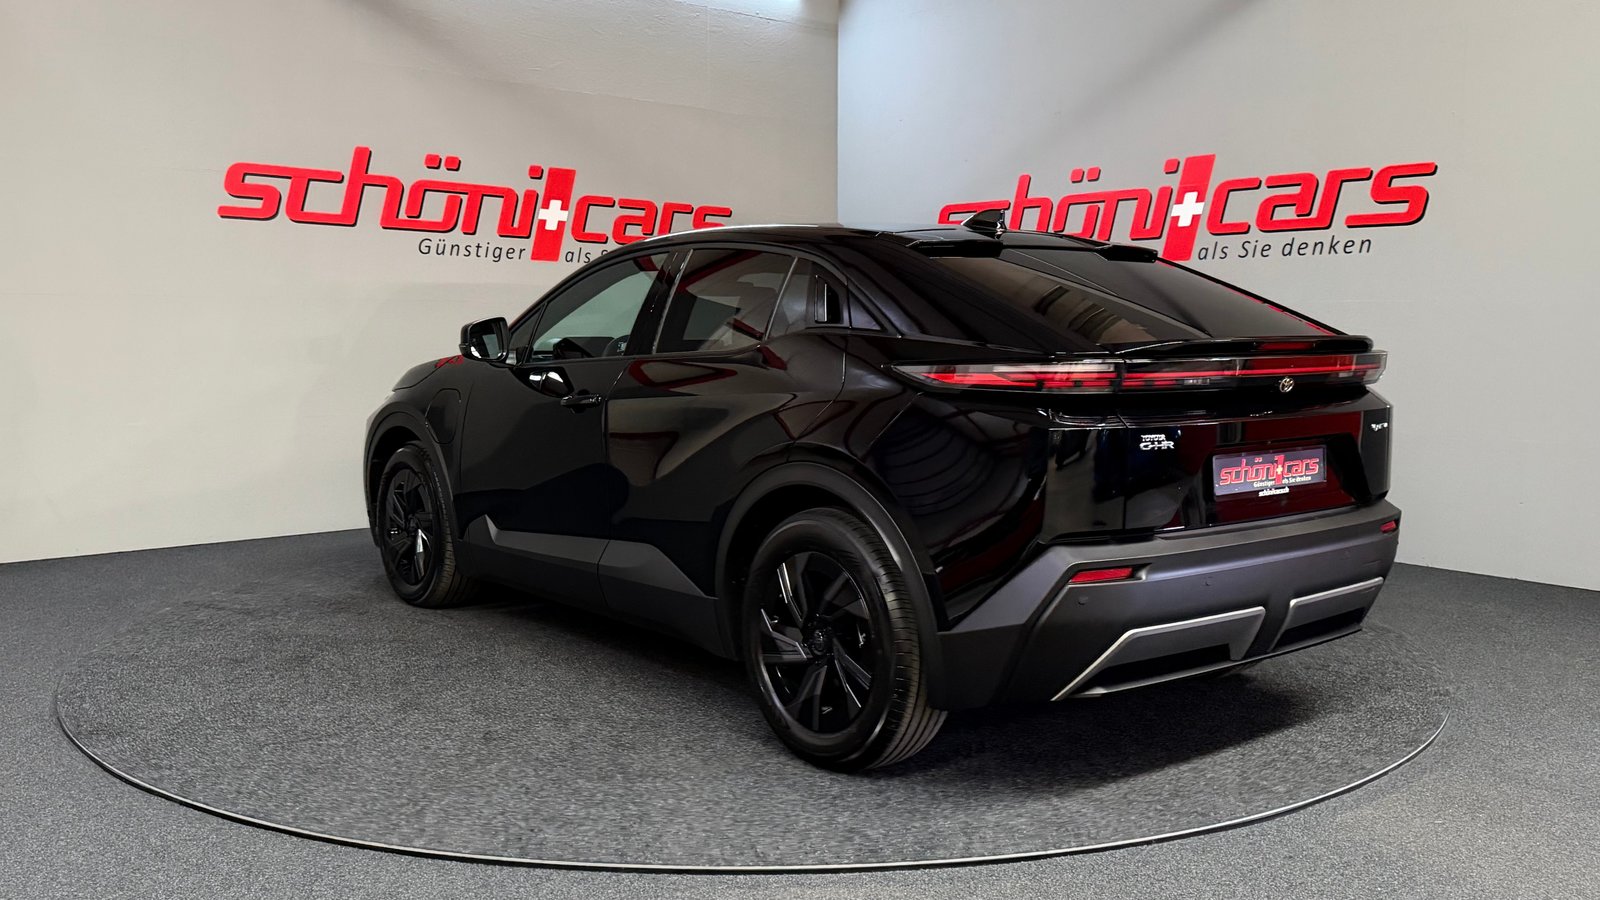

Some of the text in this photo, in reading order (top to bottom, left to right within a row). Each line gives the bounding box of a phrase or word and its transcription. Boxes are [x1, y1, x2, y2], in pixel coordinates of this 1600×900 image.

[418, 238, 592, 264] Günstiger als
[1197, 235, 1373, 261] als Sie denken
